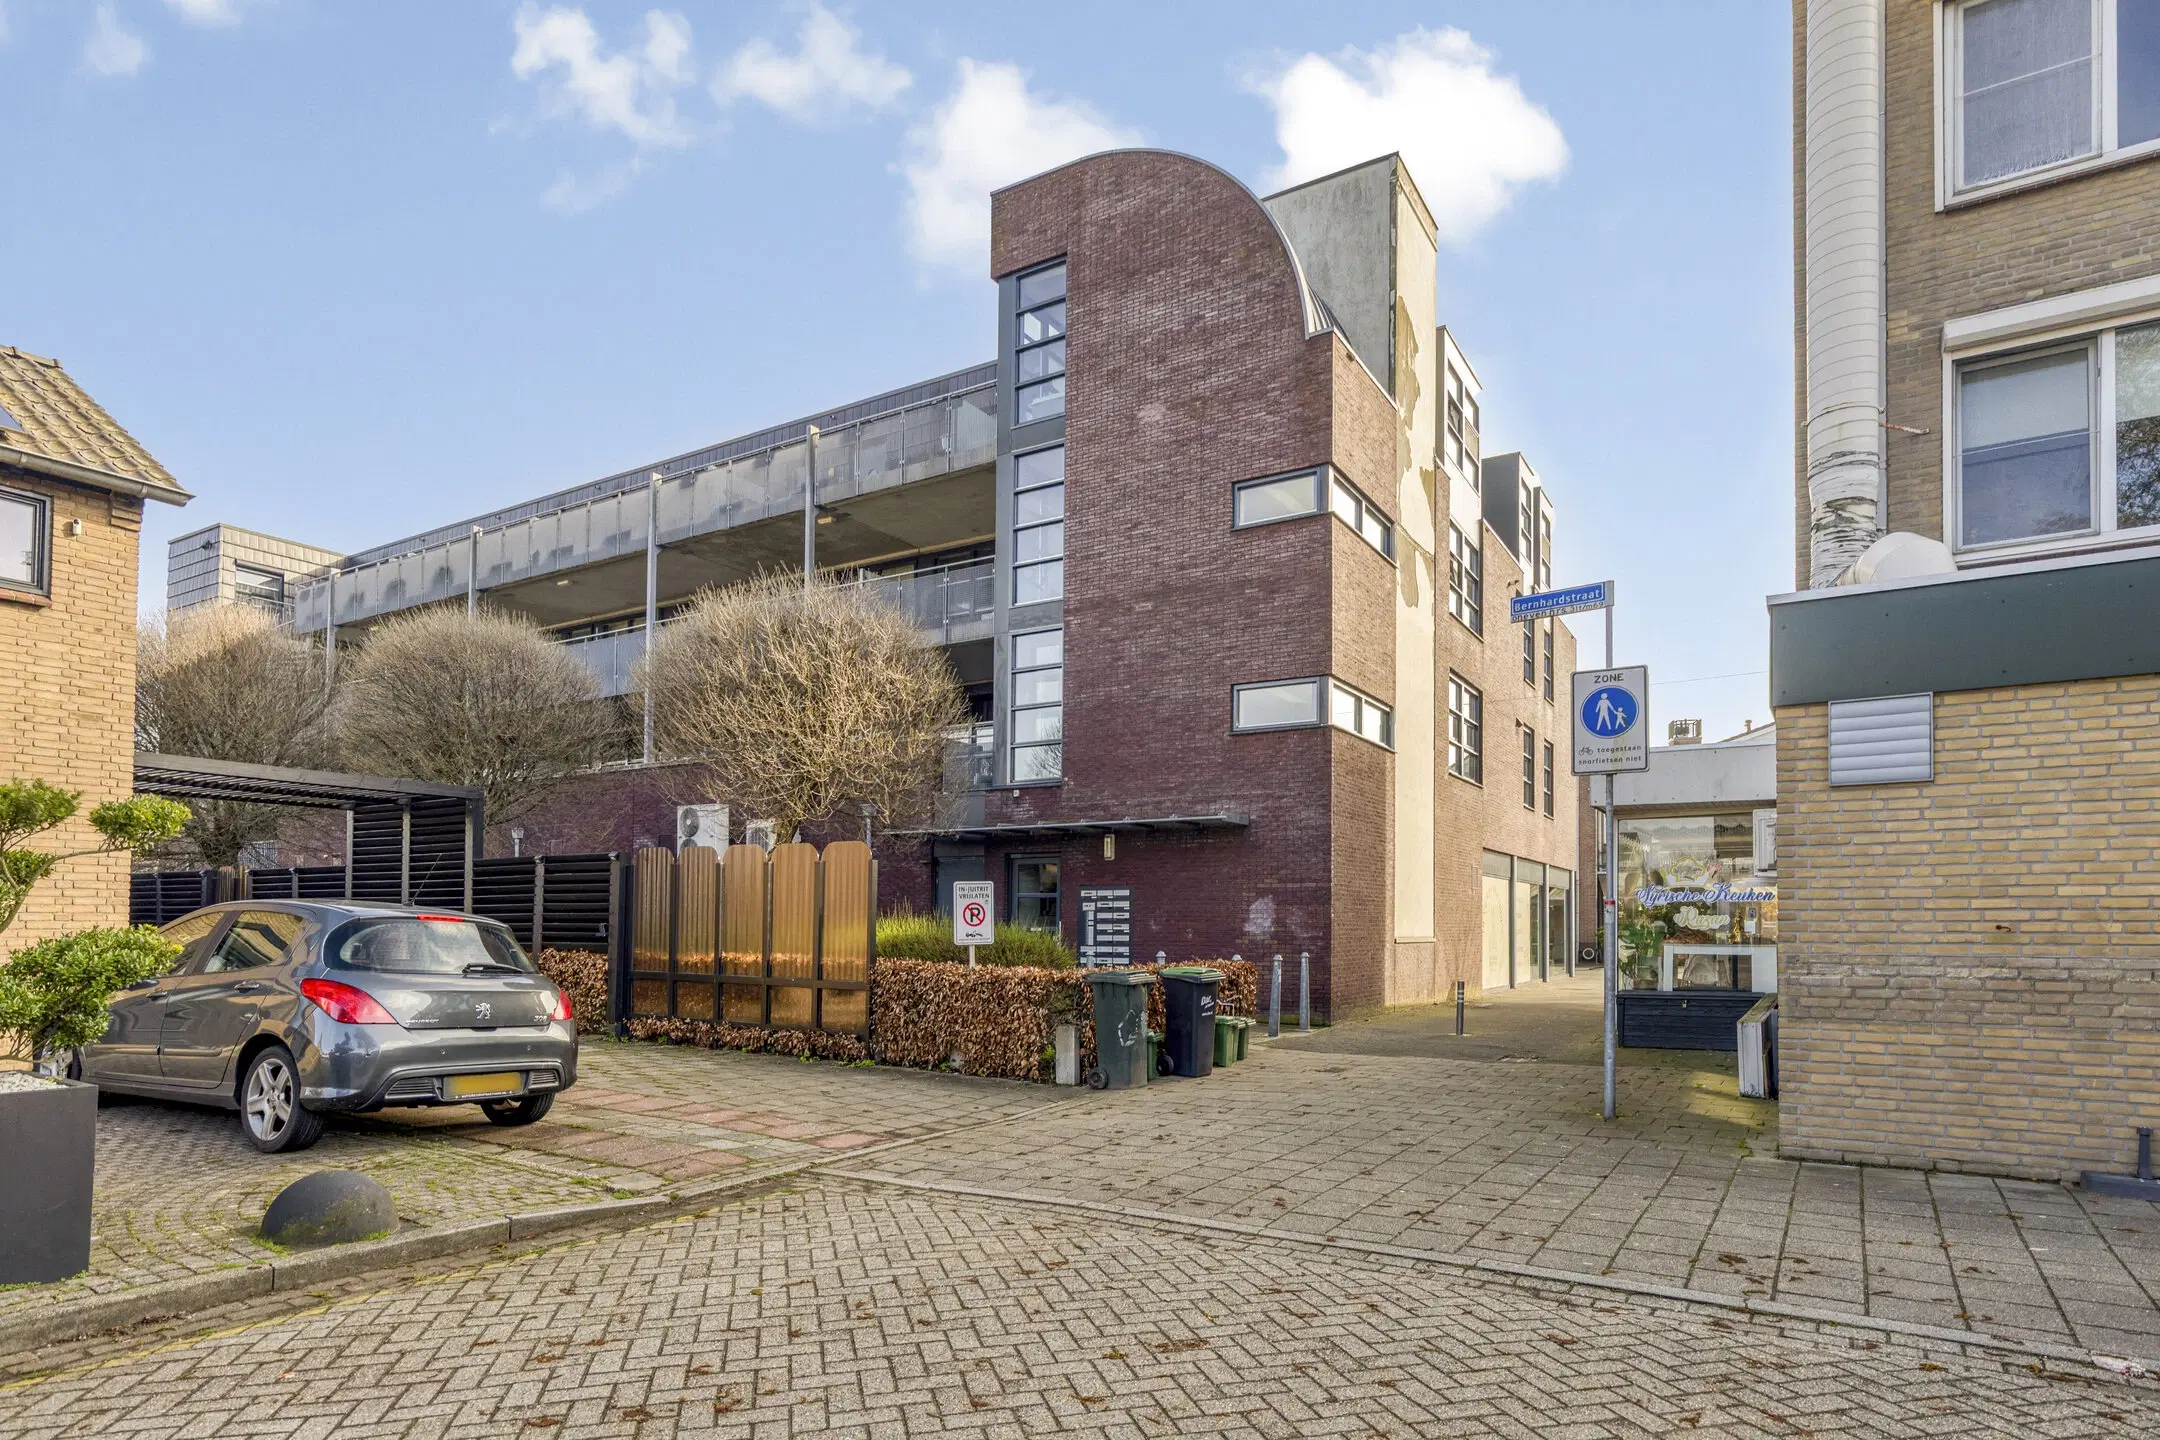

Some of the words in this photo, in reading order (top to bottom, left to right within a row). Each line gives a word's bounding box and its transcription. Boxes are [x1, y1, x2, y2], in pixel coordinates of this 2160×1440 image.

[1514, 589, 1601, 612] Bernhardstraat
[1512, 610, 1547, 622] oneven
[1594, 673, 1624, 684] ZONE
[1597, 745, 1642, 754] toegestaan
[1578, 756, 1623, 766] snorfietsen
[1636, 883, 1700, 907] Syrische
[1702, 882, 1776, 903] Keuken
